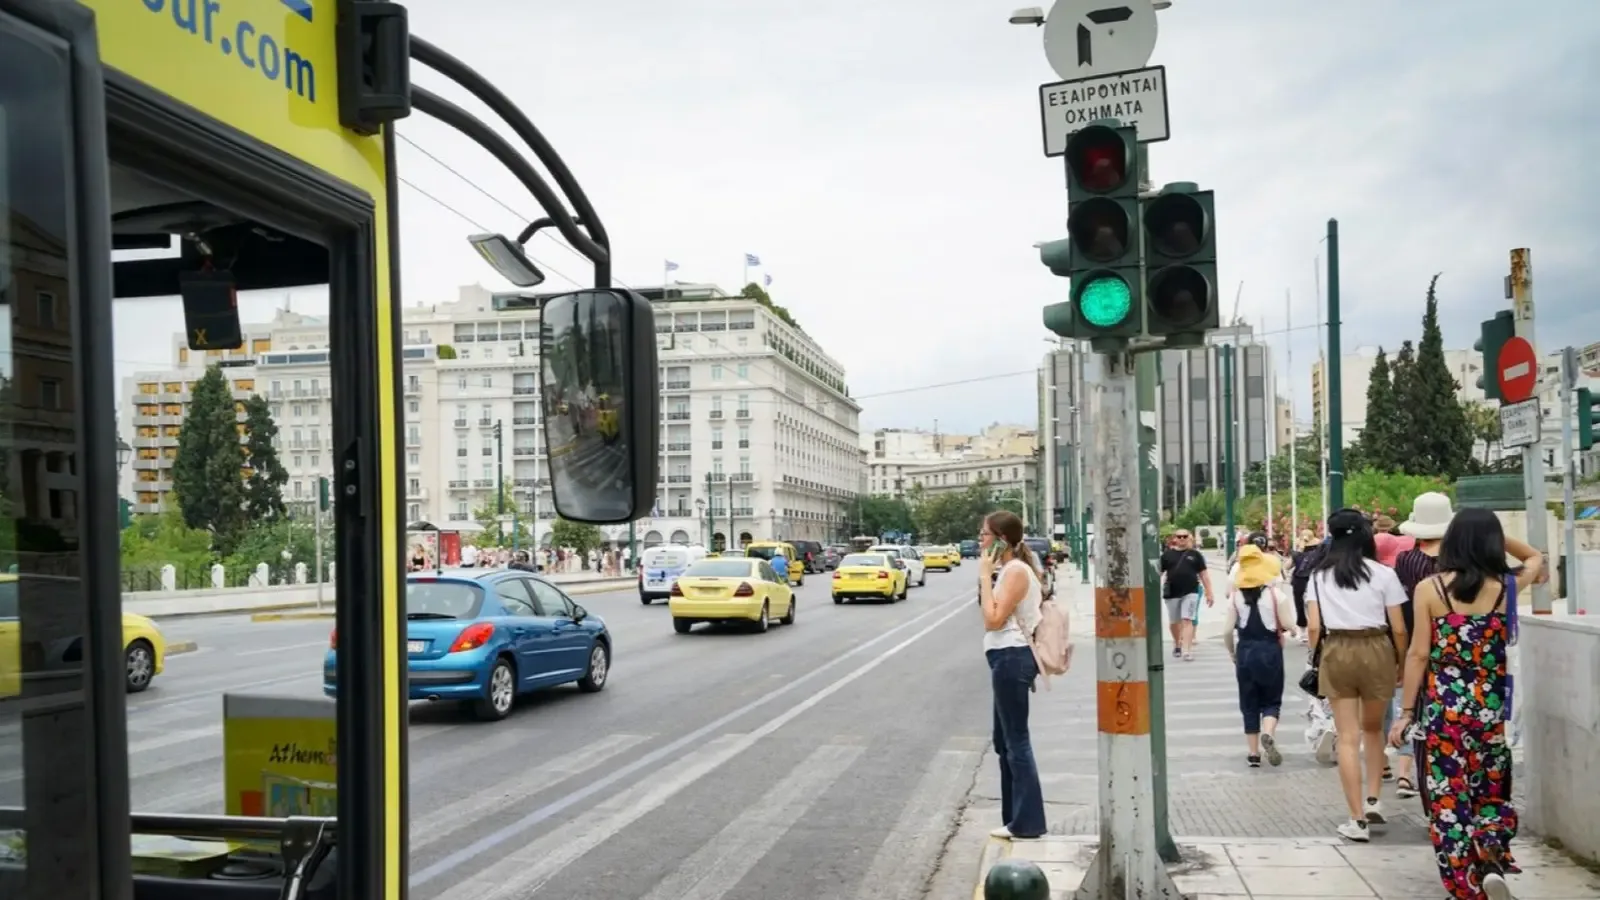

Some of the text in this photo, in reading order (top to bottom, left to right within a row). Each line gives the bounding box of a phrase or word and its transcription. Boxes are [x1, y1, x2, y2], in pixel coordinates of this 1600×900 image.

[141, 0, 316, 103] ur.com
[1048, 77, 1157, 107] ΕΞΑΙΡΟΥΝΤΑΙ
[1065, 100, 1143, 124] ΟΧΗΜΑΤΑ
